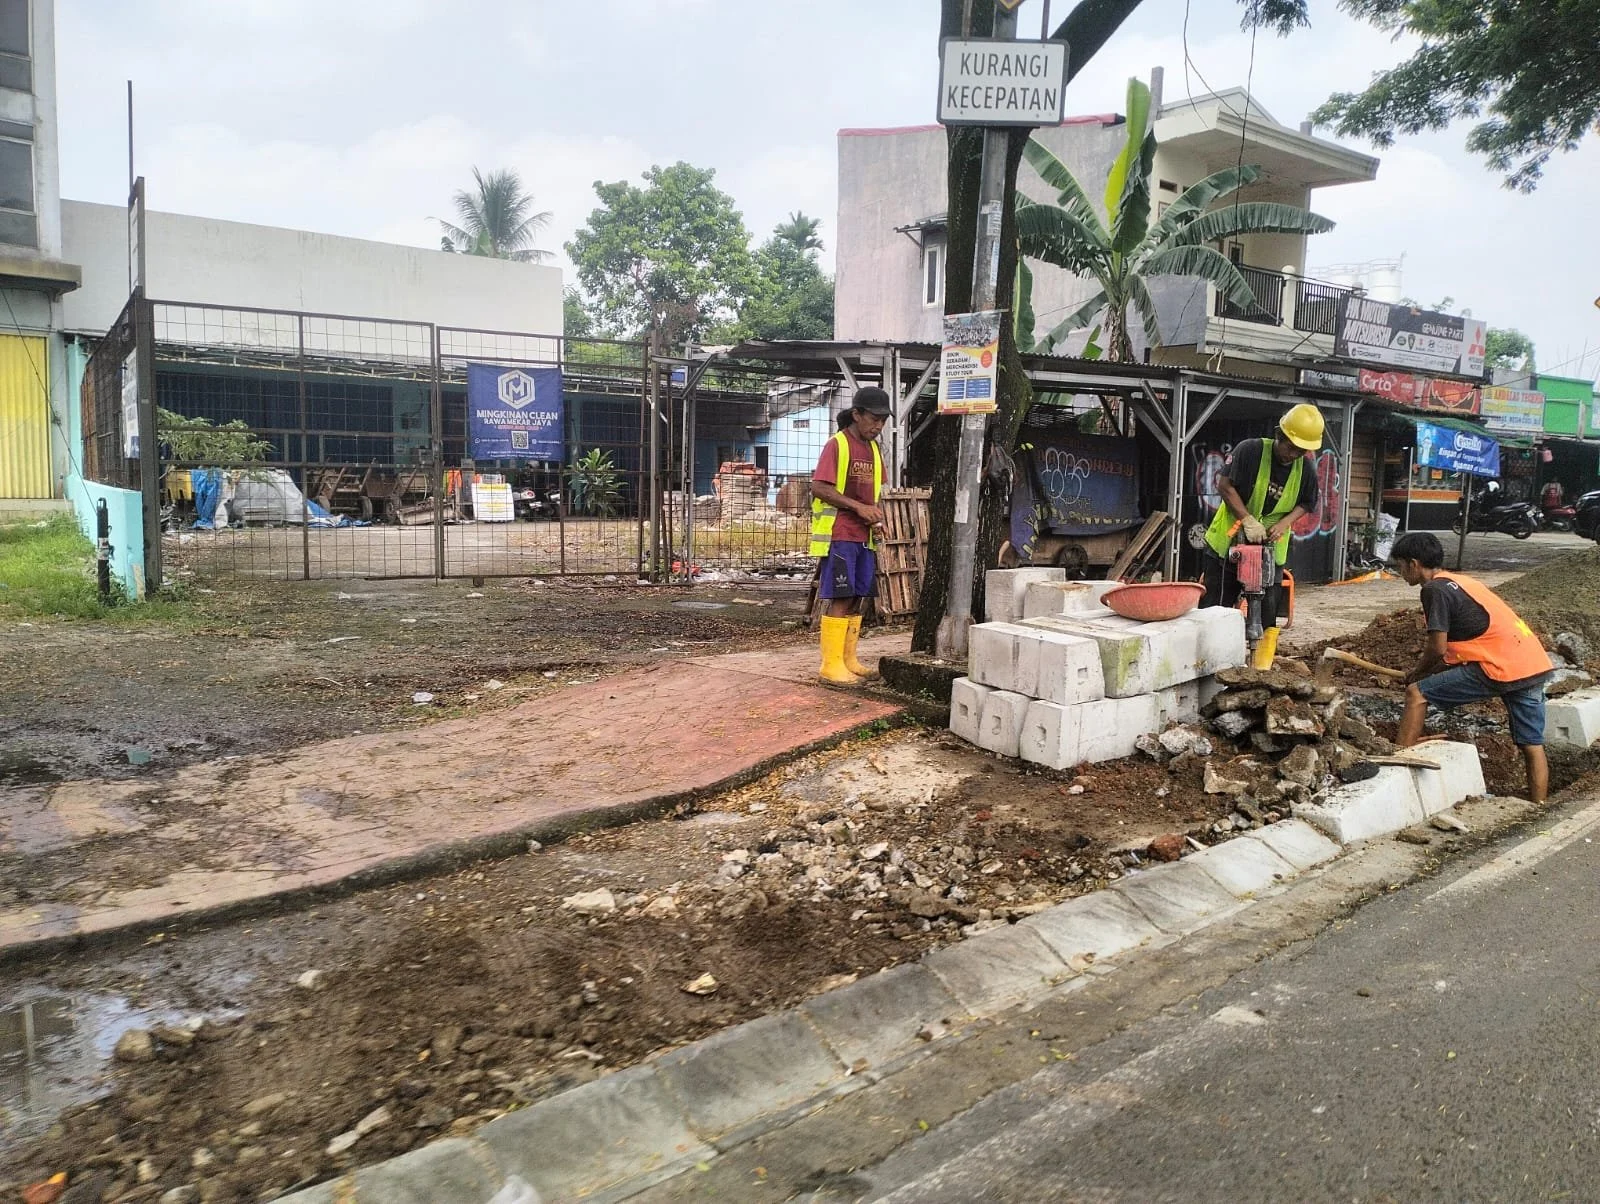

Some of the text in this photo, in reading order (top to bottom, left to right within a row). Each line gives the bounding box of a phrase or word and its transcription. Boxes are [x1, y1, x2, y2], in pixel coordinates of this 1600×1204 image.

[960, 52, 1049, 78] KURANGI
[947, 85, 1057, 111] KECEPATAN
[1361, 300, 1390, 325] MOTOR
[1342, 319, 1392, 347] MITSUBISHI
[1448, 327, 1464, 340] PART
[476, 409, 558, 420] MINGKINAN CLEAN
[507, 418, 531, 426] MEKAR
